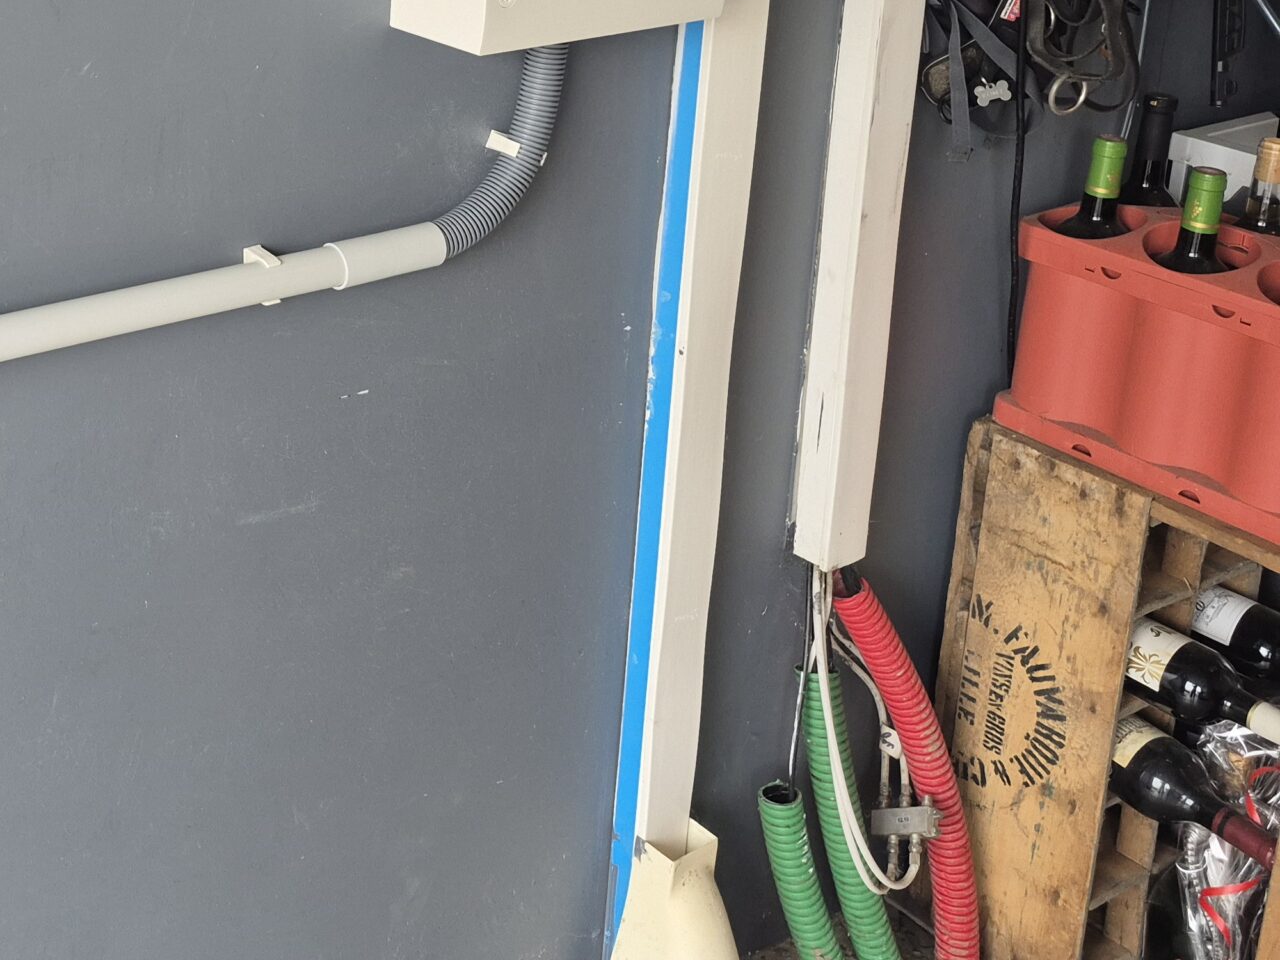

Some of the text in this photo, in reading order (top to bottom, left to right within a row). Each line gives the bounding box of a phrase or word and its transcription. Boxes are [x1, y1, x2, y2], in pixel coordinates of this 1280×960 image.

[957, 649, 983, 726] LILLE
[991, 651, 1016, 693] VINS
[983, 710, 1007, 755] GROS
